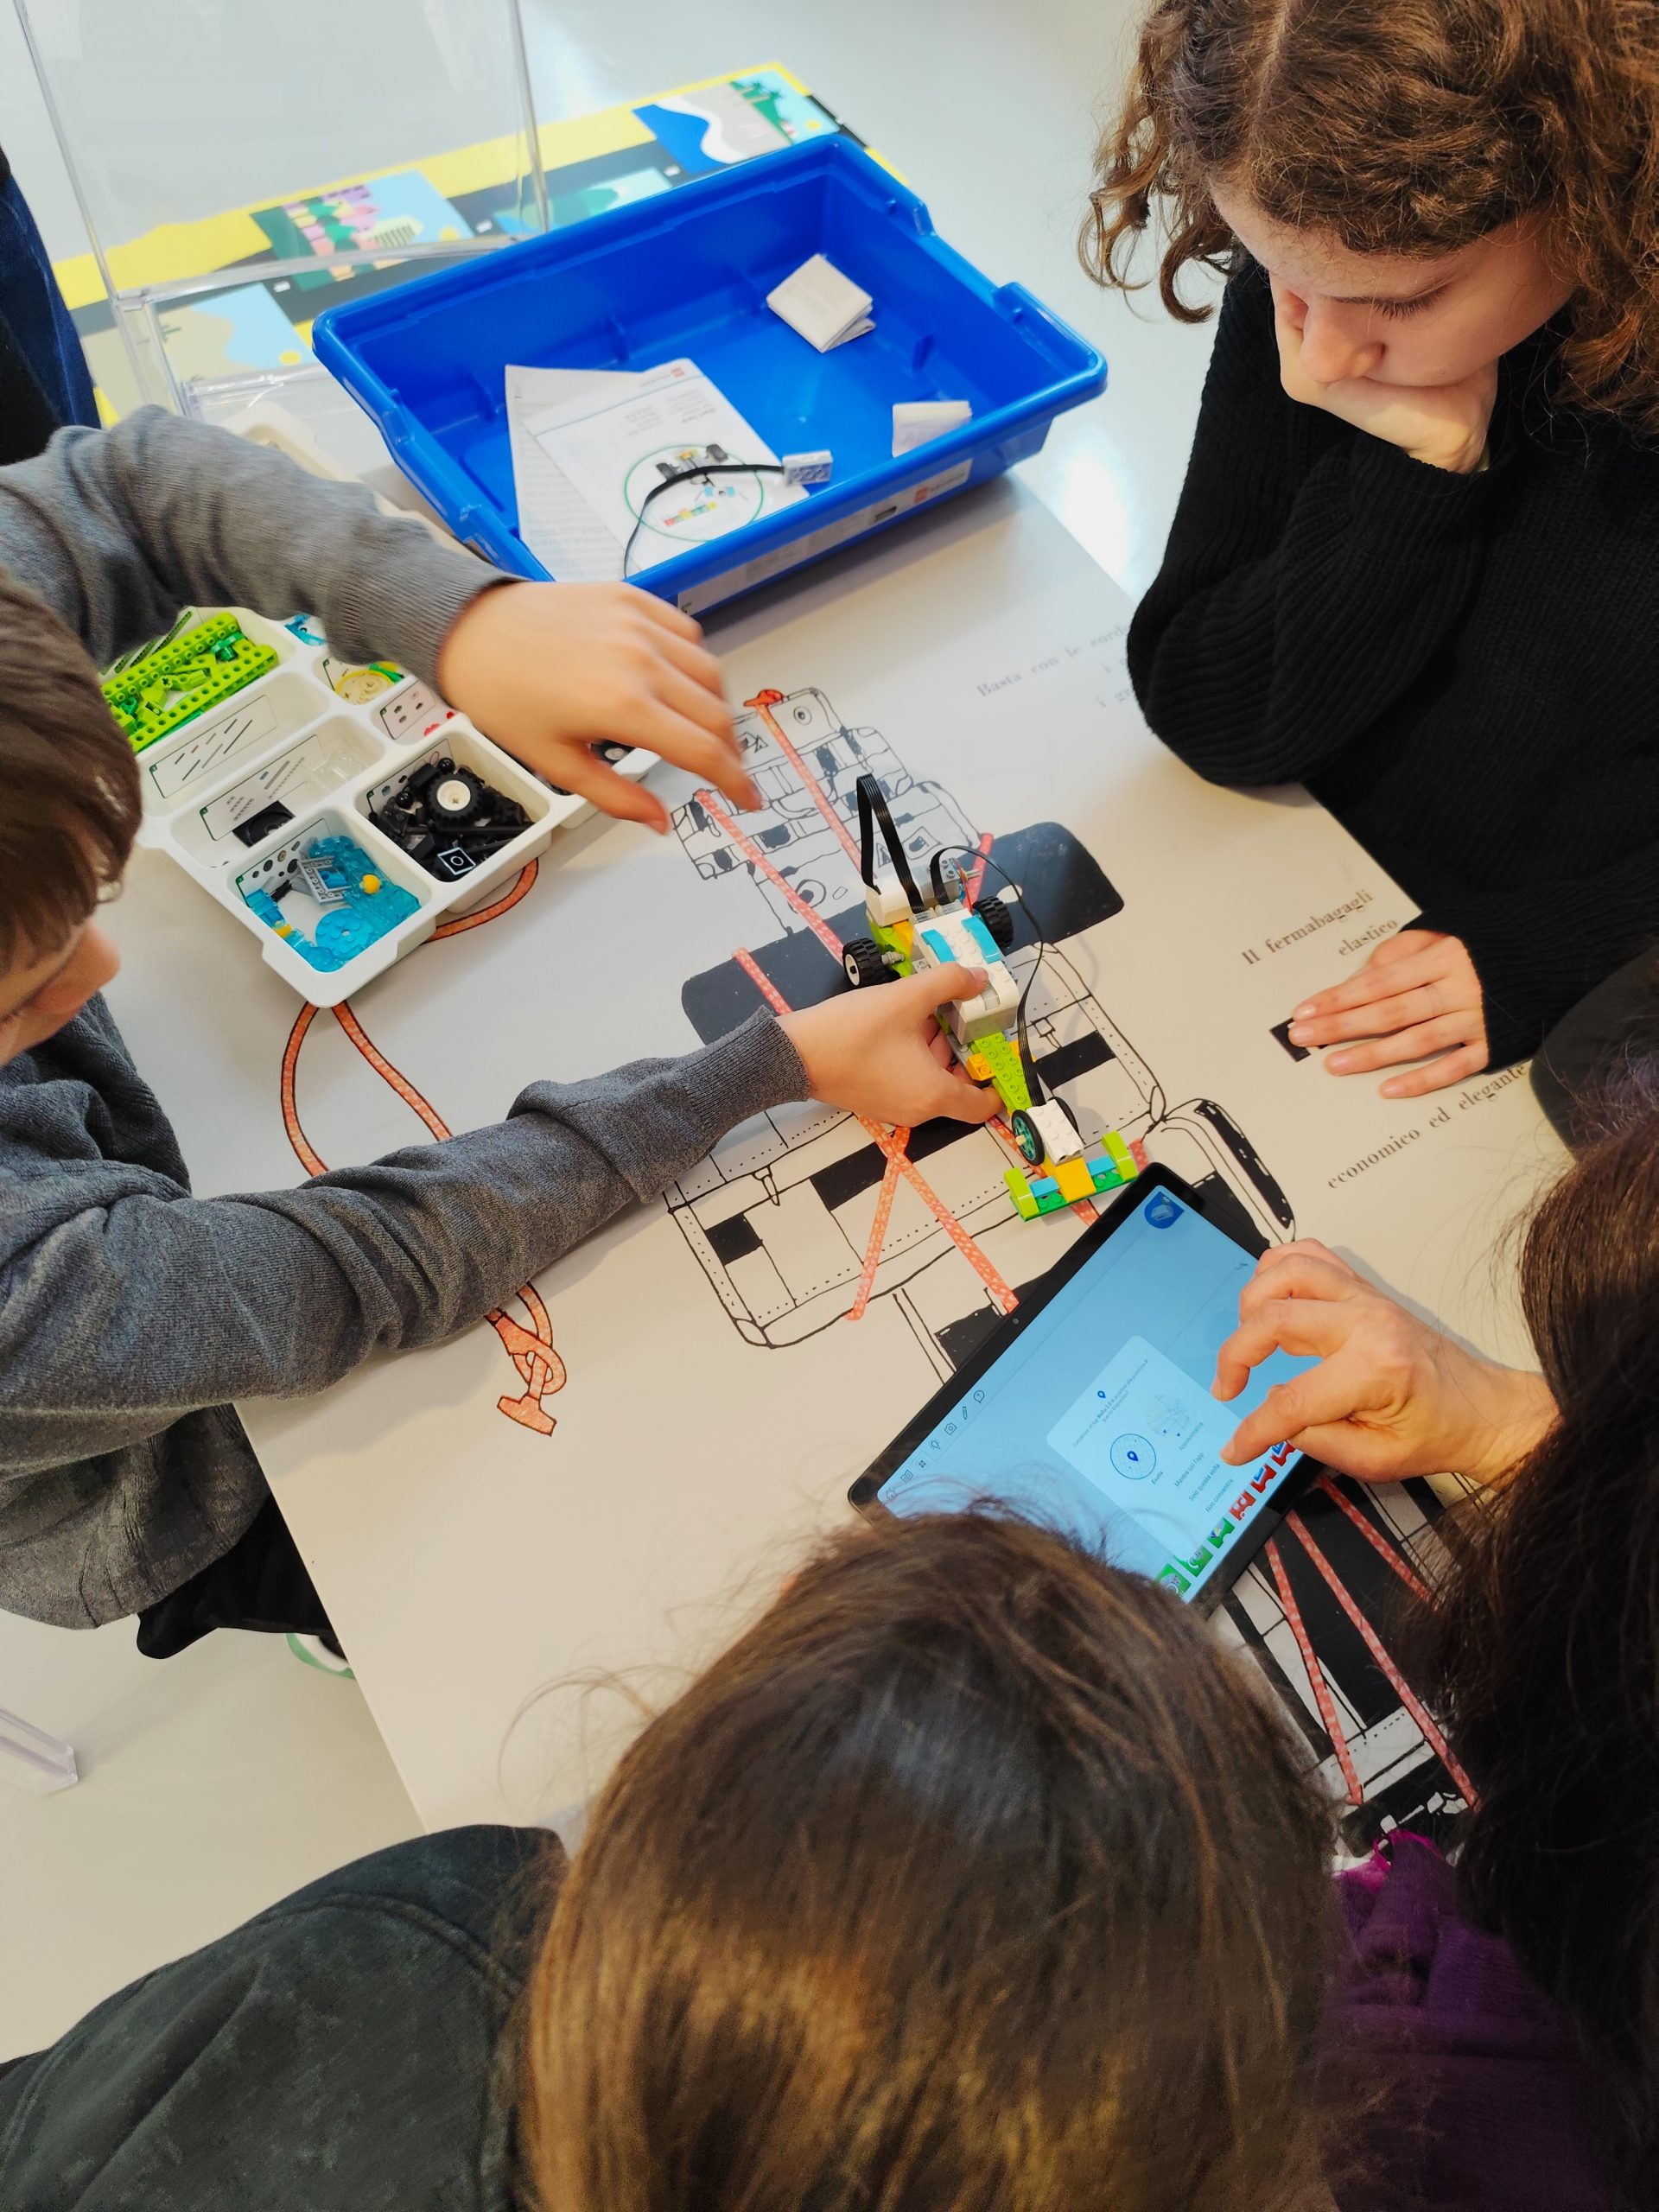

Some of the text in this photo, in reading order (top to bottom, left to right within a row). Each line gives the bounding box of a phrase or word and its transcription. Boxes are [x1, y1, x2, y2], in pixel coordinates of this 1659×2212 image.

[976, 671, 1022, 696] Basta
[1030, 656, 1059, 674] con
[1064, 645, 1081, 658] le
[1242, 888, 1374, 965] Il fermabagagli
[1338, 918, 1399, 957] elastico
[1327, 1064, 1528, 1190] economico ed elegante
